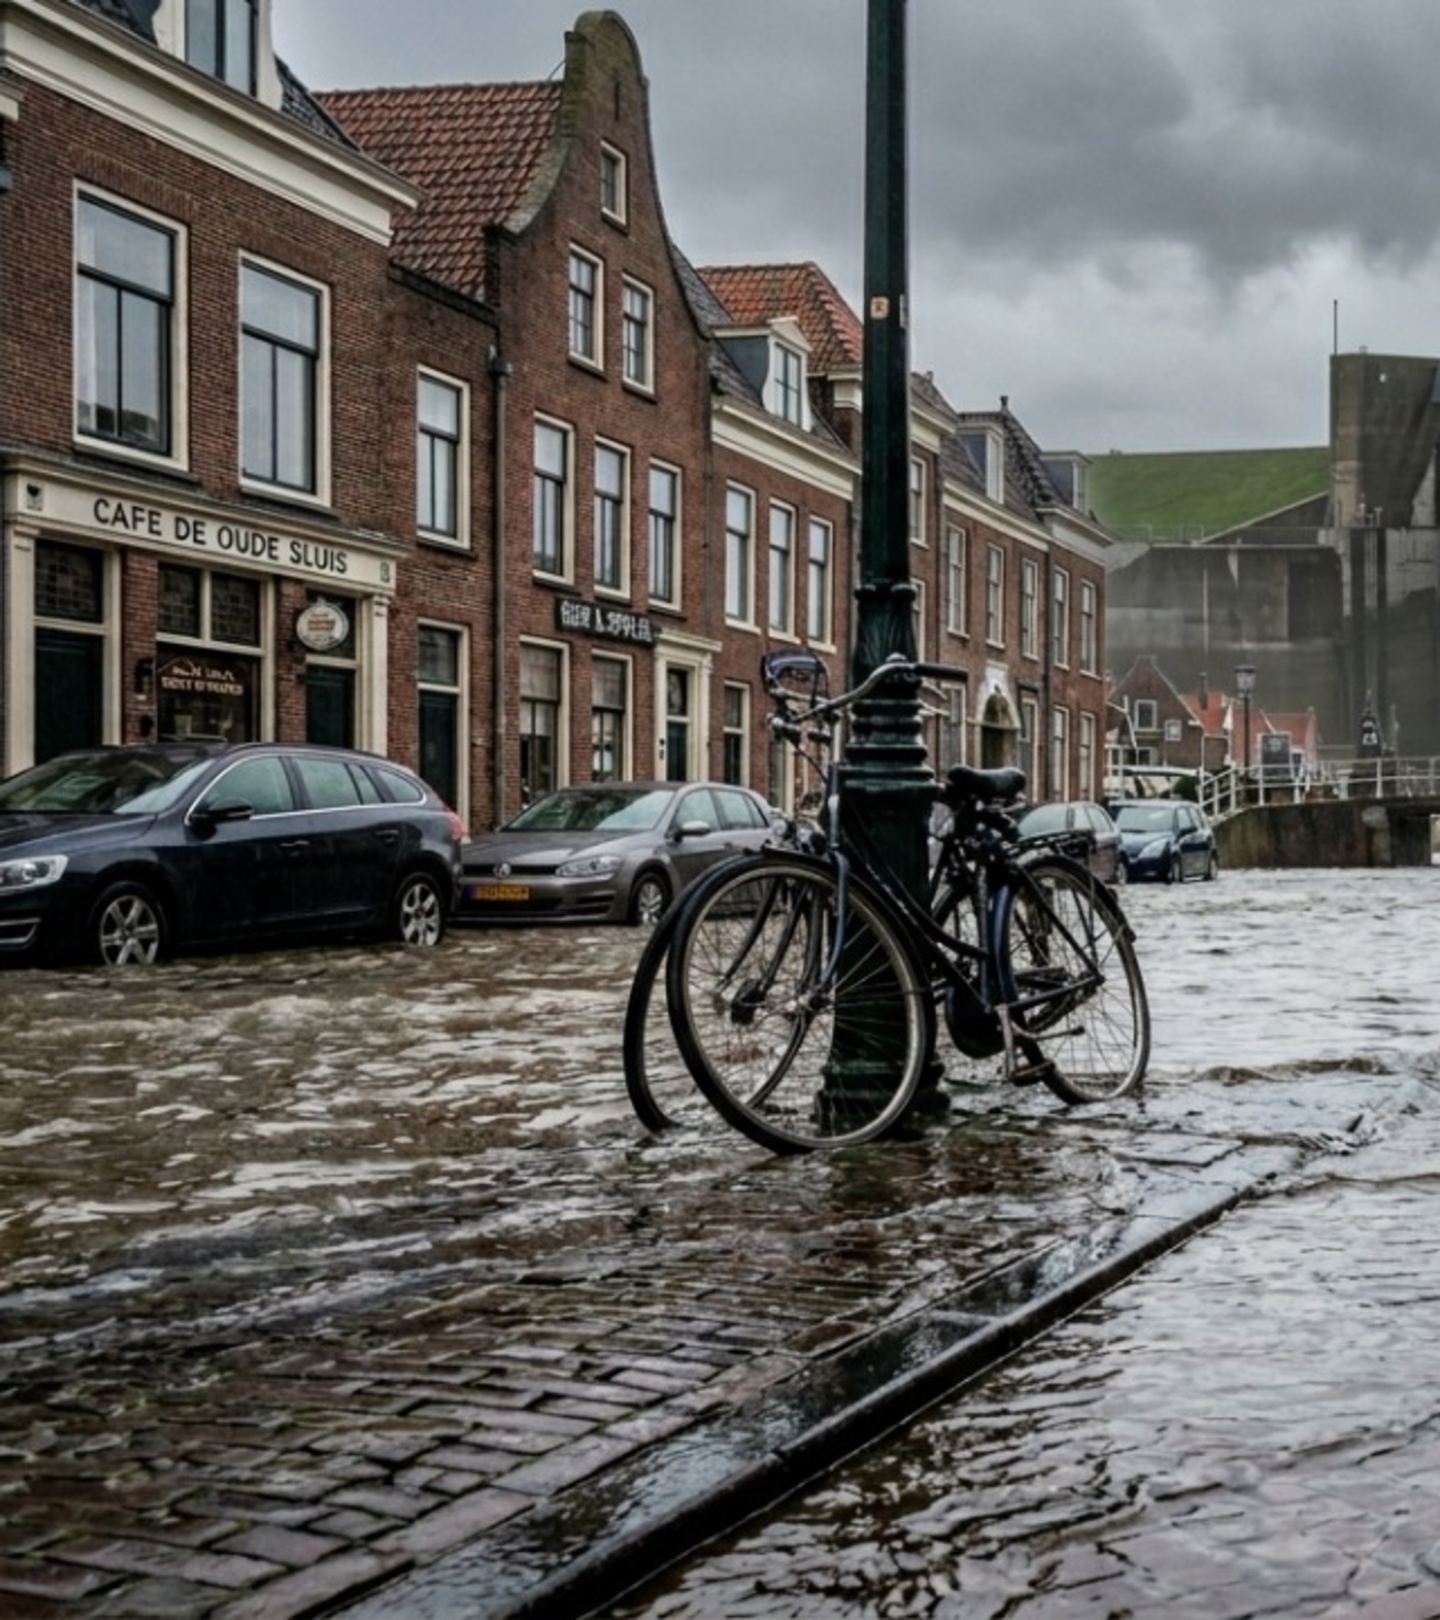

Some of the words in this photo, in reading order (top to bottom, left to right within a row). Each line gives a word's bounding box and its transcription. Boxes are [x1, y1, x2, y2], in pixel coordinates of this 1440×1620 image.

[93, 498, 162, 536] CAFE
[174, 516, 206, 545] DE
[217, 525, 280, 561] OUDE
[289, 540, 347, 574] SLUIS
